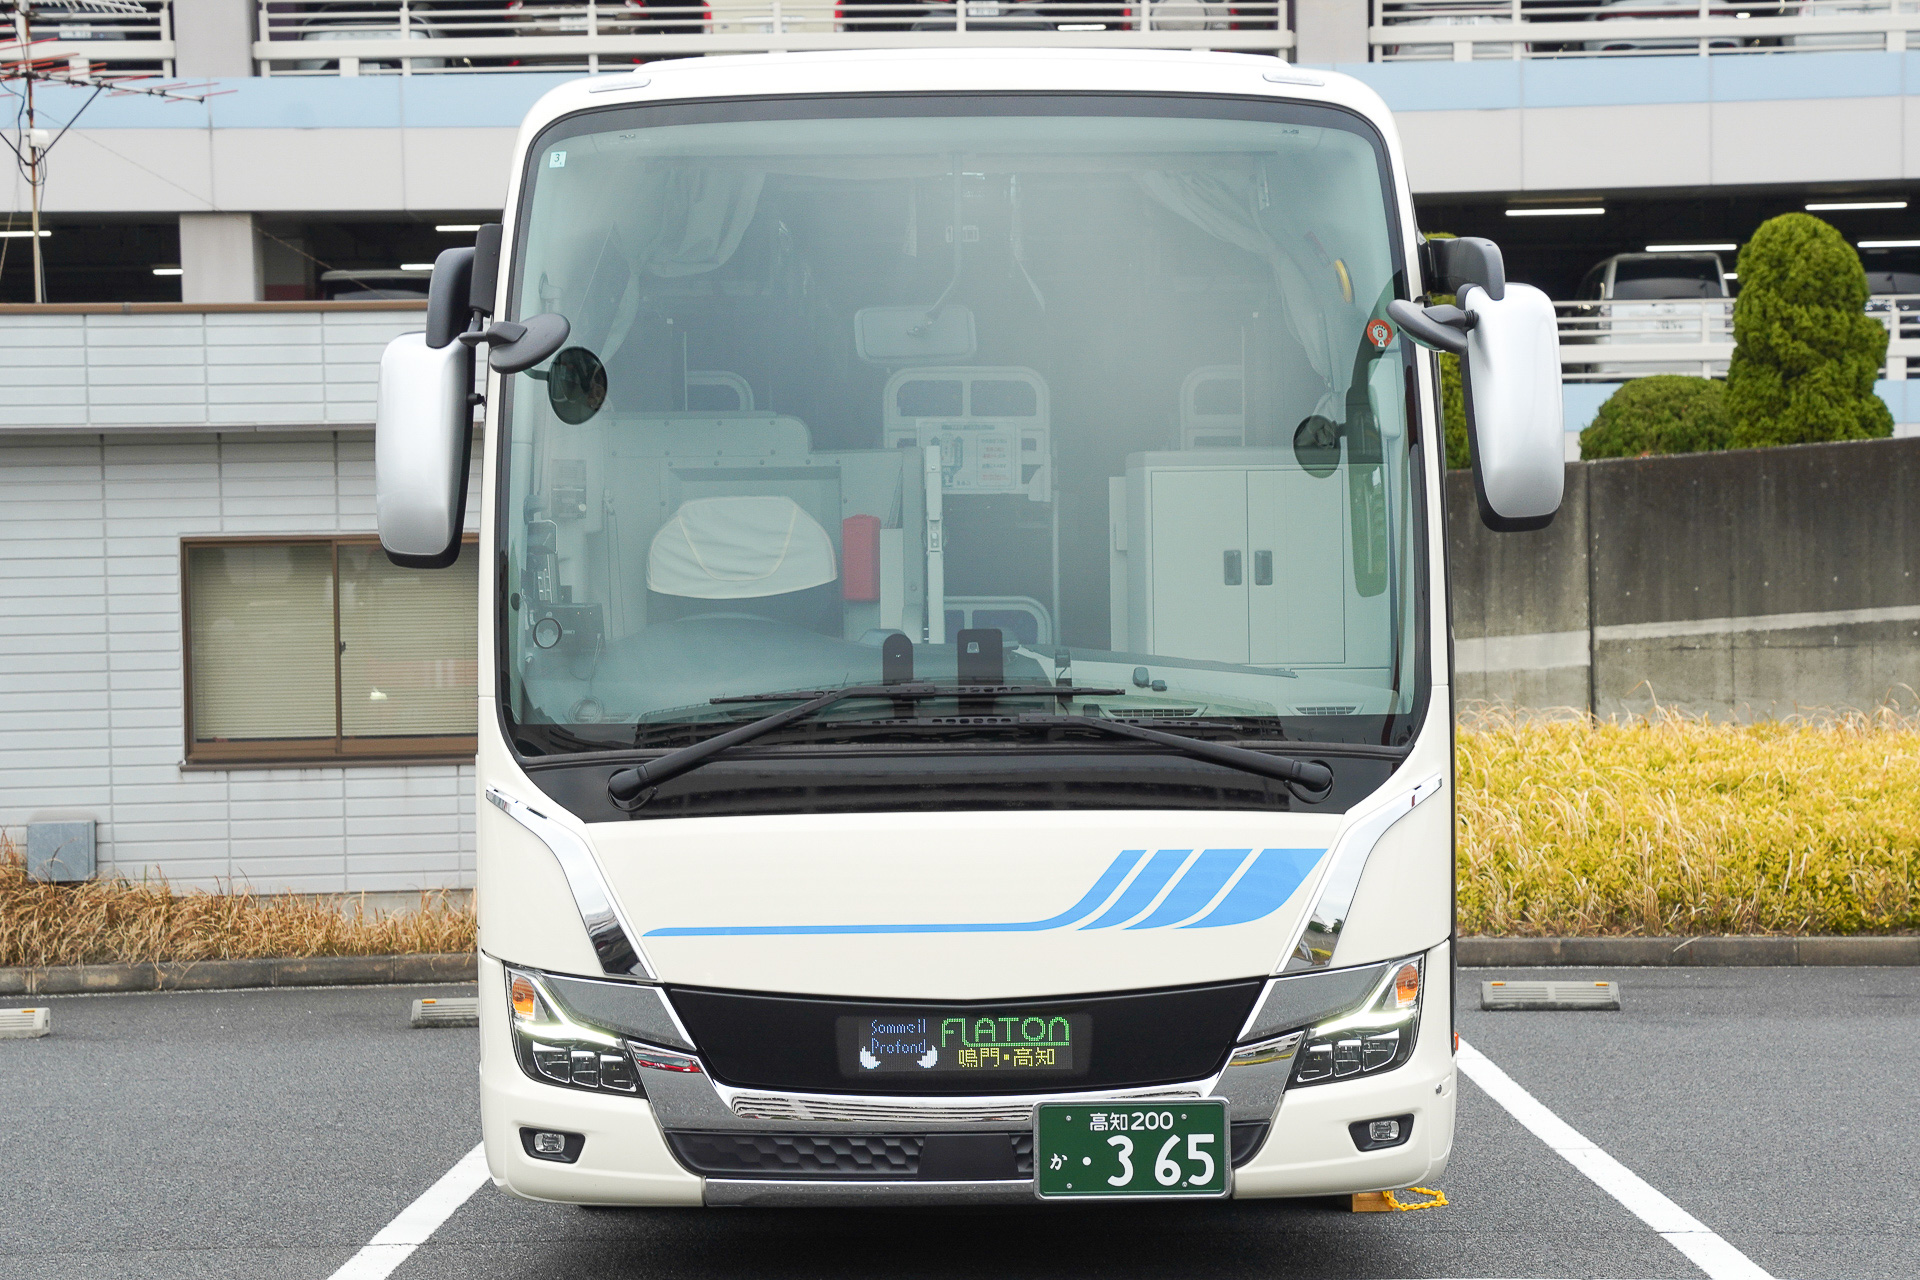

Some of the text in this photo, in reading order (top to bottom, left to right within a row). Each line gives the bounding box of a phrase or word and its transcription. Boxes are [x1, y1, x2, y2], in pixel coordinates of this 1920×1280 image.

[1378, 329, 1383, 338] 8
[871, 1018, 926, 1035] Sommeil
[871, 1037, 926, 1054] Profond
[1049, 1153, 1068, 1171] か
